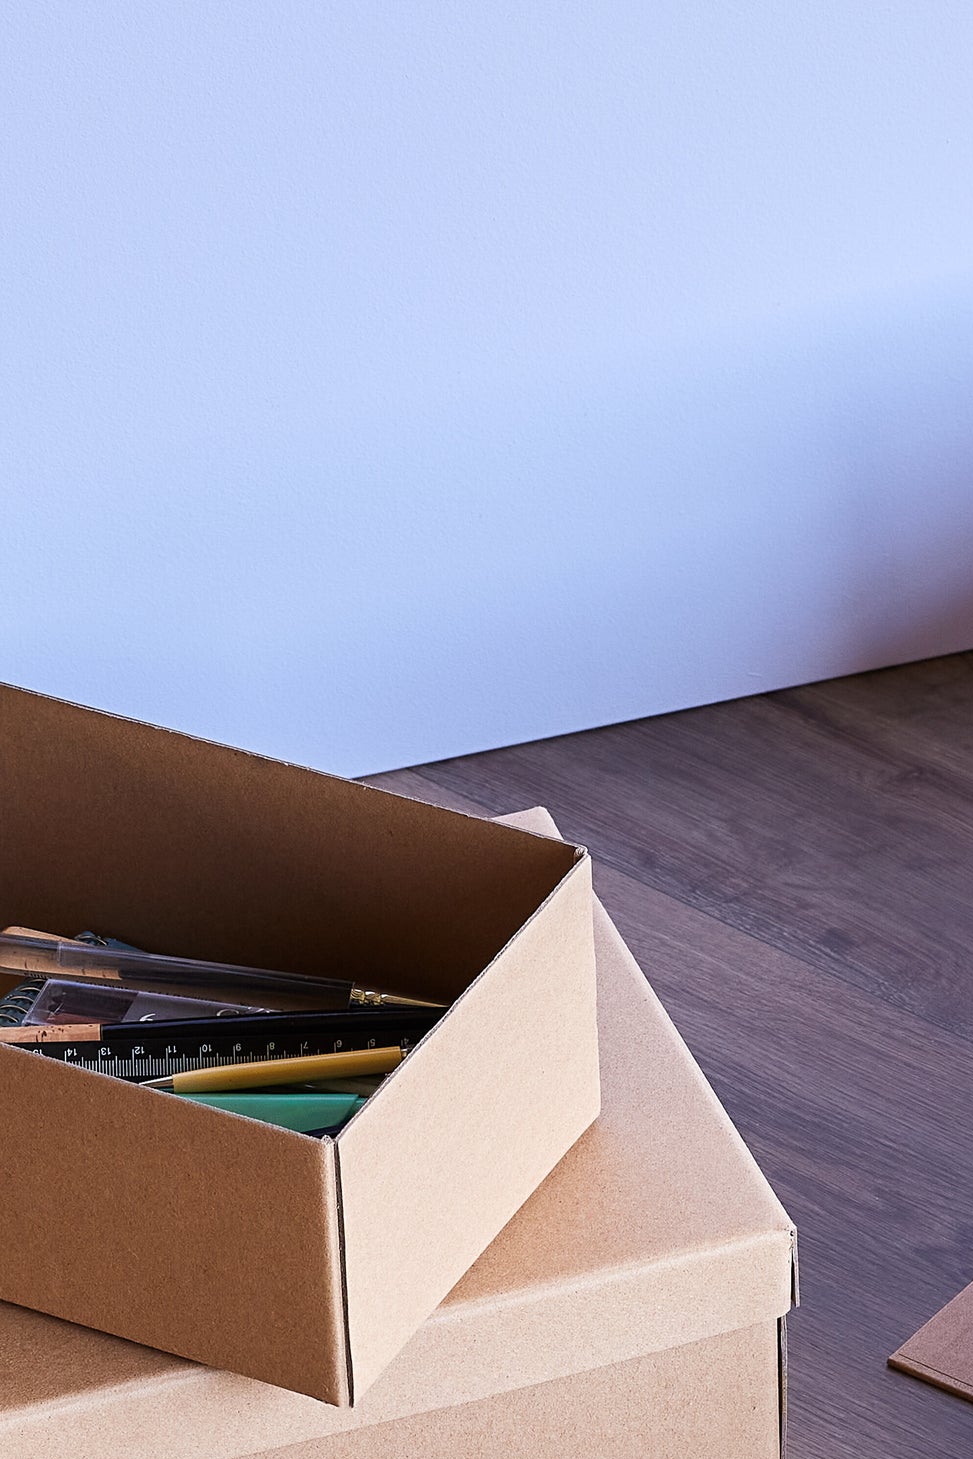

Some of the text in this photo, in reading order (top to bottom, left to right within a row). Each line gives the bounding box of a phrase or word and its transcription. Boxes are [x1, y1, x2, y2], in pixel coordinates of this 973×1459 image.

[202, 1044, 212, 1052] 10
[235, 1043, 241, 1051] 9
[270, 1042, 275, 1050] 8
[303, 1041, 308, 1049] 7
[337, 1040, 342, 1048] 6
[67, 1048, 77, 1056] 14
[101, 1047, 111, 1055] 13
[135, 1046, 144, 1054] 12
[168, 1045, 176, 1053] 11
